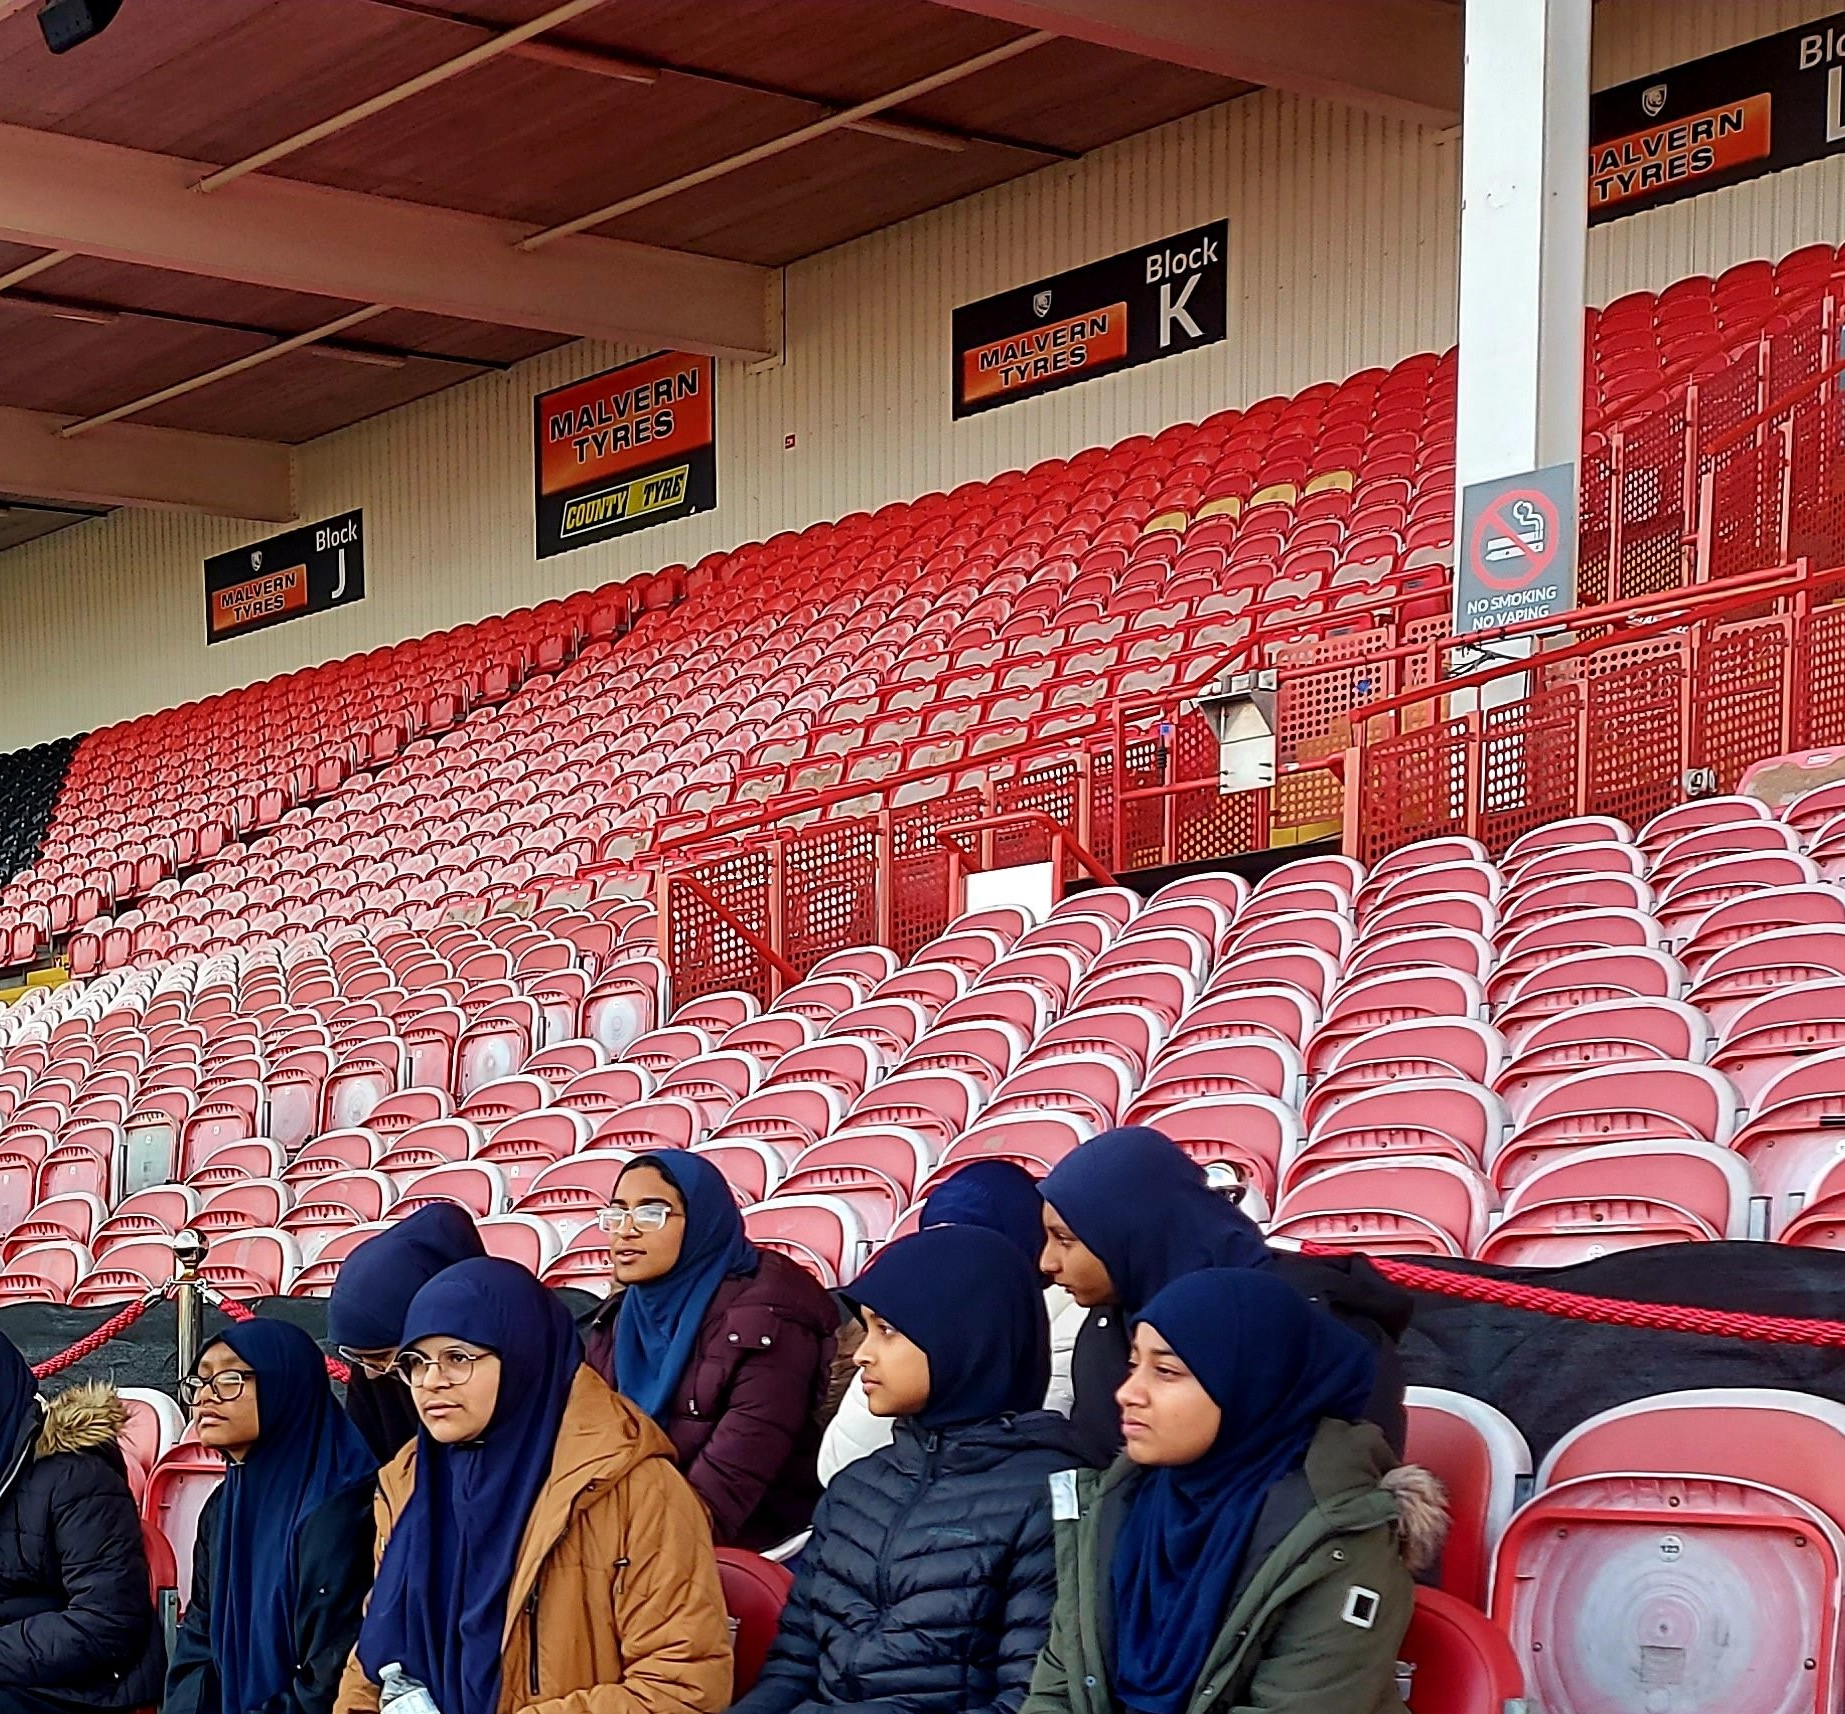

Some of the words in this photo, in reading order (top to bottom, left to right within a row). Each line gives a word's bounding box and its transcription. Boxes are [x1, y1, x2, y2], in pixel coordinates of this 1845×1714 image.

[1589, 108, 1745, 177] ALVERN
[1594, 147, 1714, 202] TYRES
[1146, 237, 1218, 284] Block
[1159, 273, 1204, 348] K
[979, 314, 1109, 371] MALVERN
[999, 345, 1086, 386] TYRES
[549, 367, 699, 443] MALVERN
[572, 409, 674, 464] TYRES
[566, 490, 628, 529] COUNTY
[643, 474, 685, 507] TYRE
[316, 519, 357, 552] Block
[221, 572, 296, 609] MALVERN
[331, 548, 346, 599] J
[233, 594, 285, 622] TYRES
[1467, 599, 1489, 615] NO
[1490, 586, 1557, 610] SMOKING
[1472, 615, 1494, 631] NO
[1496, 604, 1550, 625] VAPING
